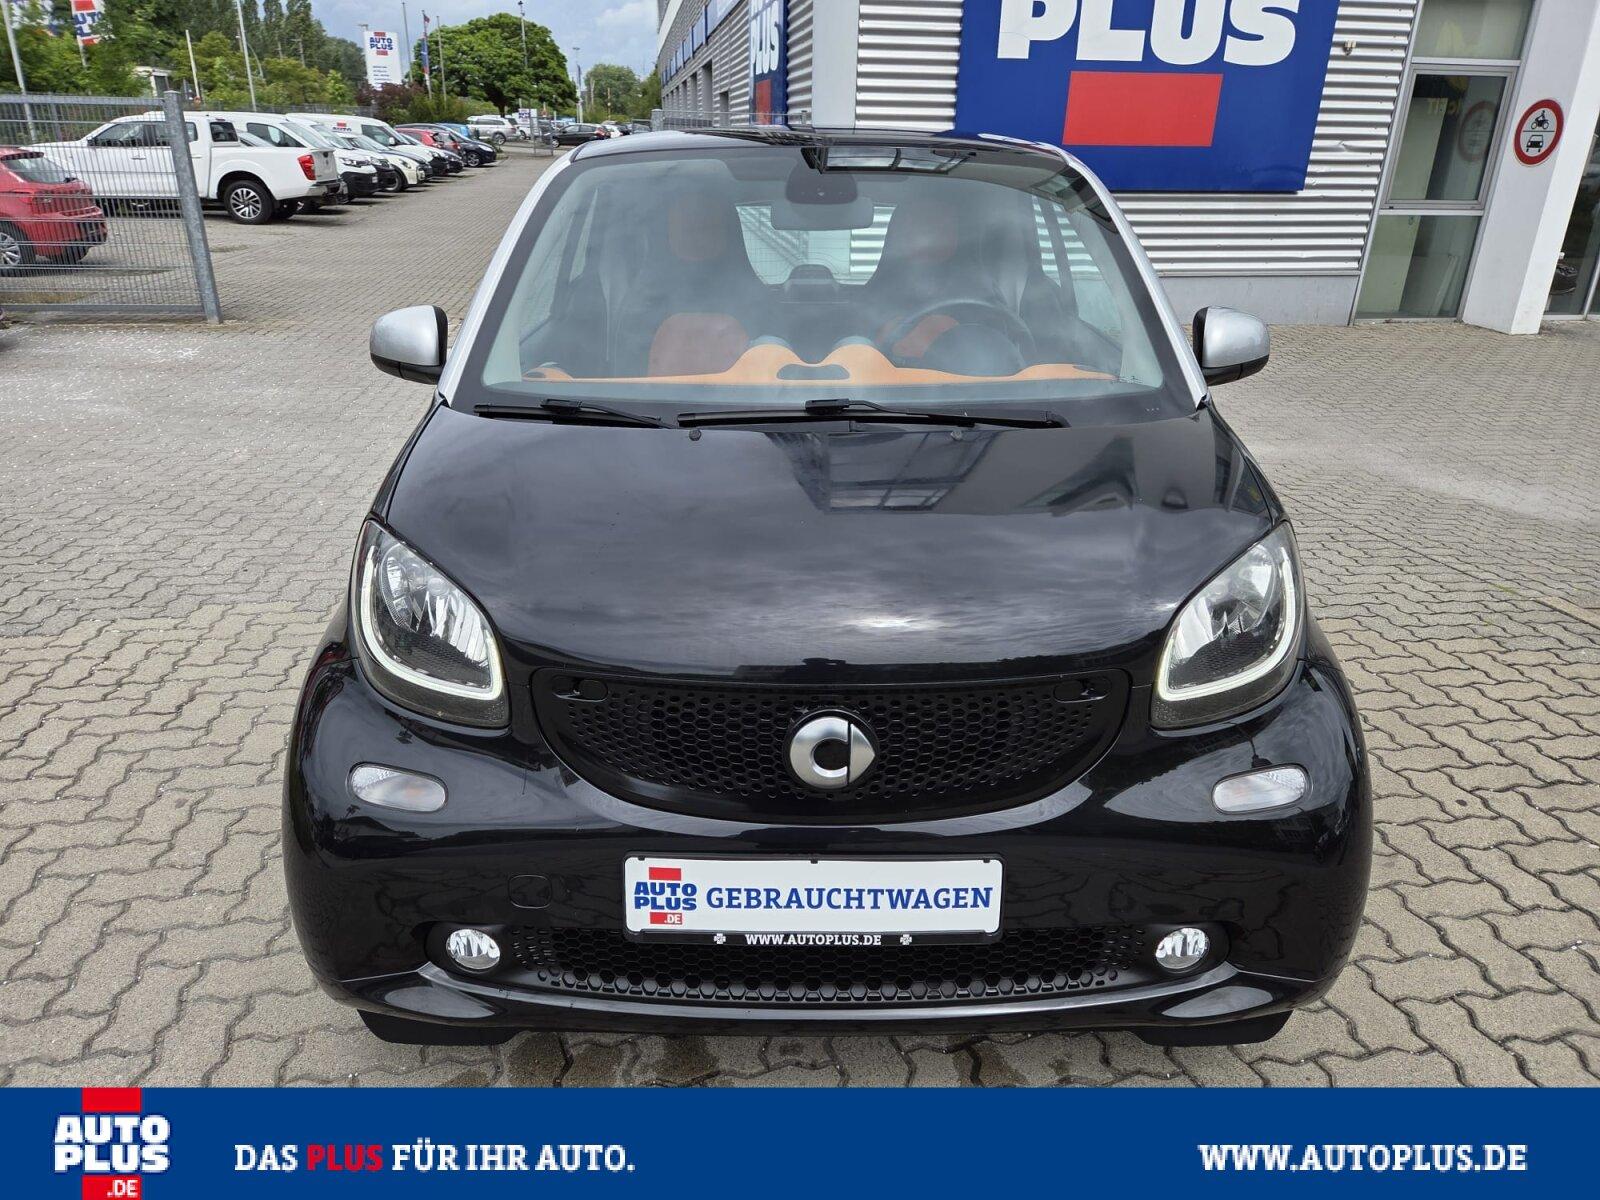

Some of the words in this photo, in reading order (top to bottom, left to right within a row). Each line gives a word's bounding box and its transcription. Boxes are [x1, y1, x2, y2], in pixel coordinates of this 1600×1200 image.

[997, 0, 1301, 66] PLUS
[634, 882, 697, 896] AUTO
[634, 897, 697, 911] PLUS
[706, 887, 993, 910] GEBRAUCHTWAGEN
[664, 914, 681, 924] .DE
[745, 934, 882, 946] WWW.AUTOPLUS.DE
